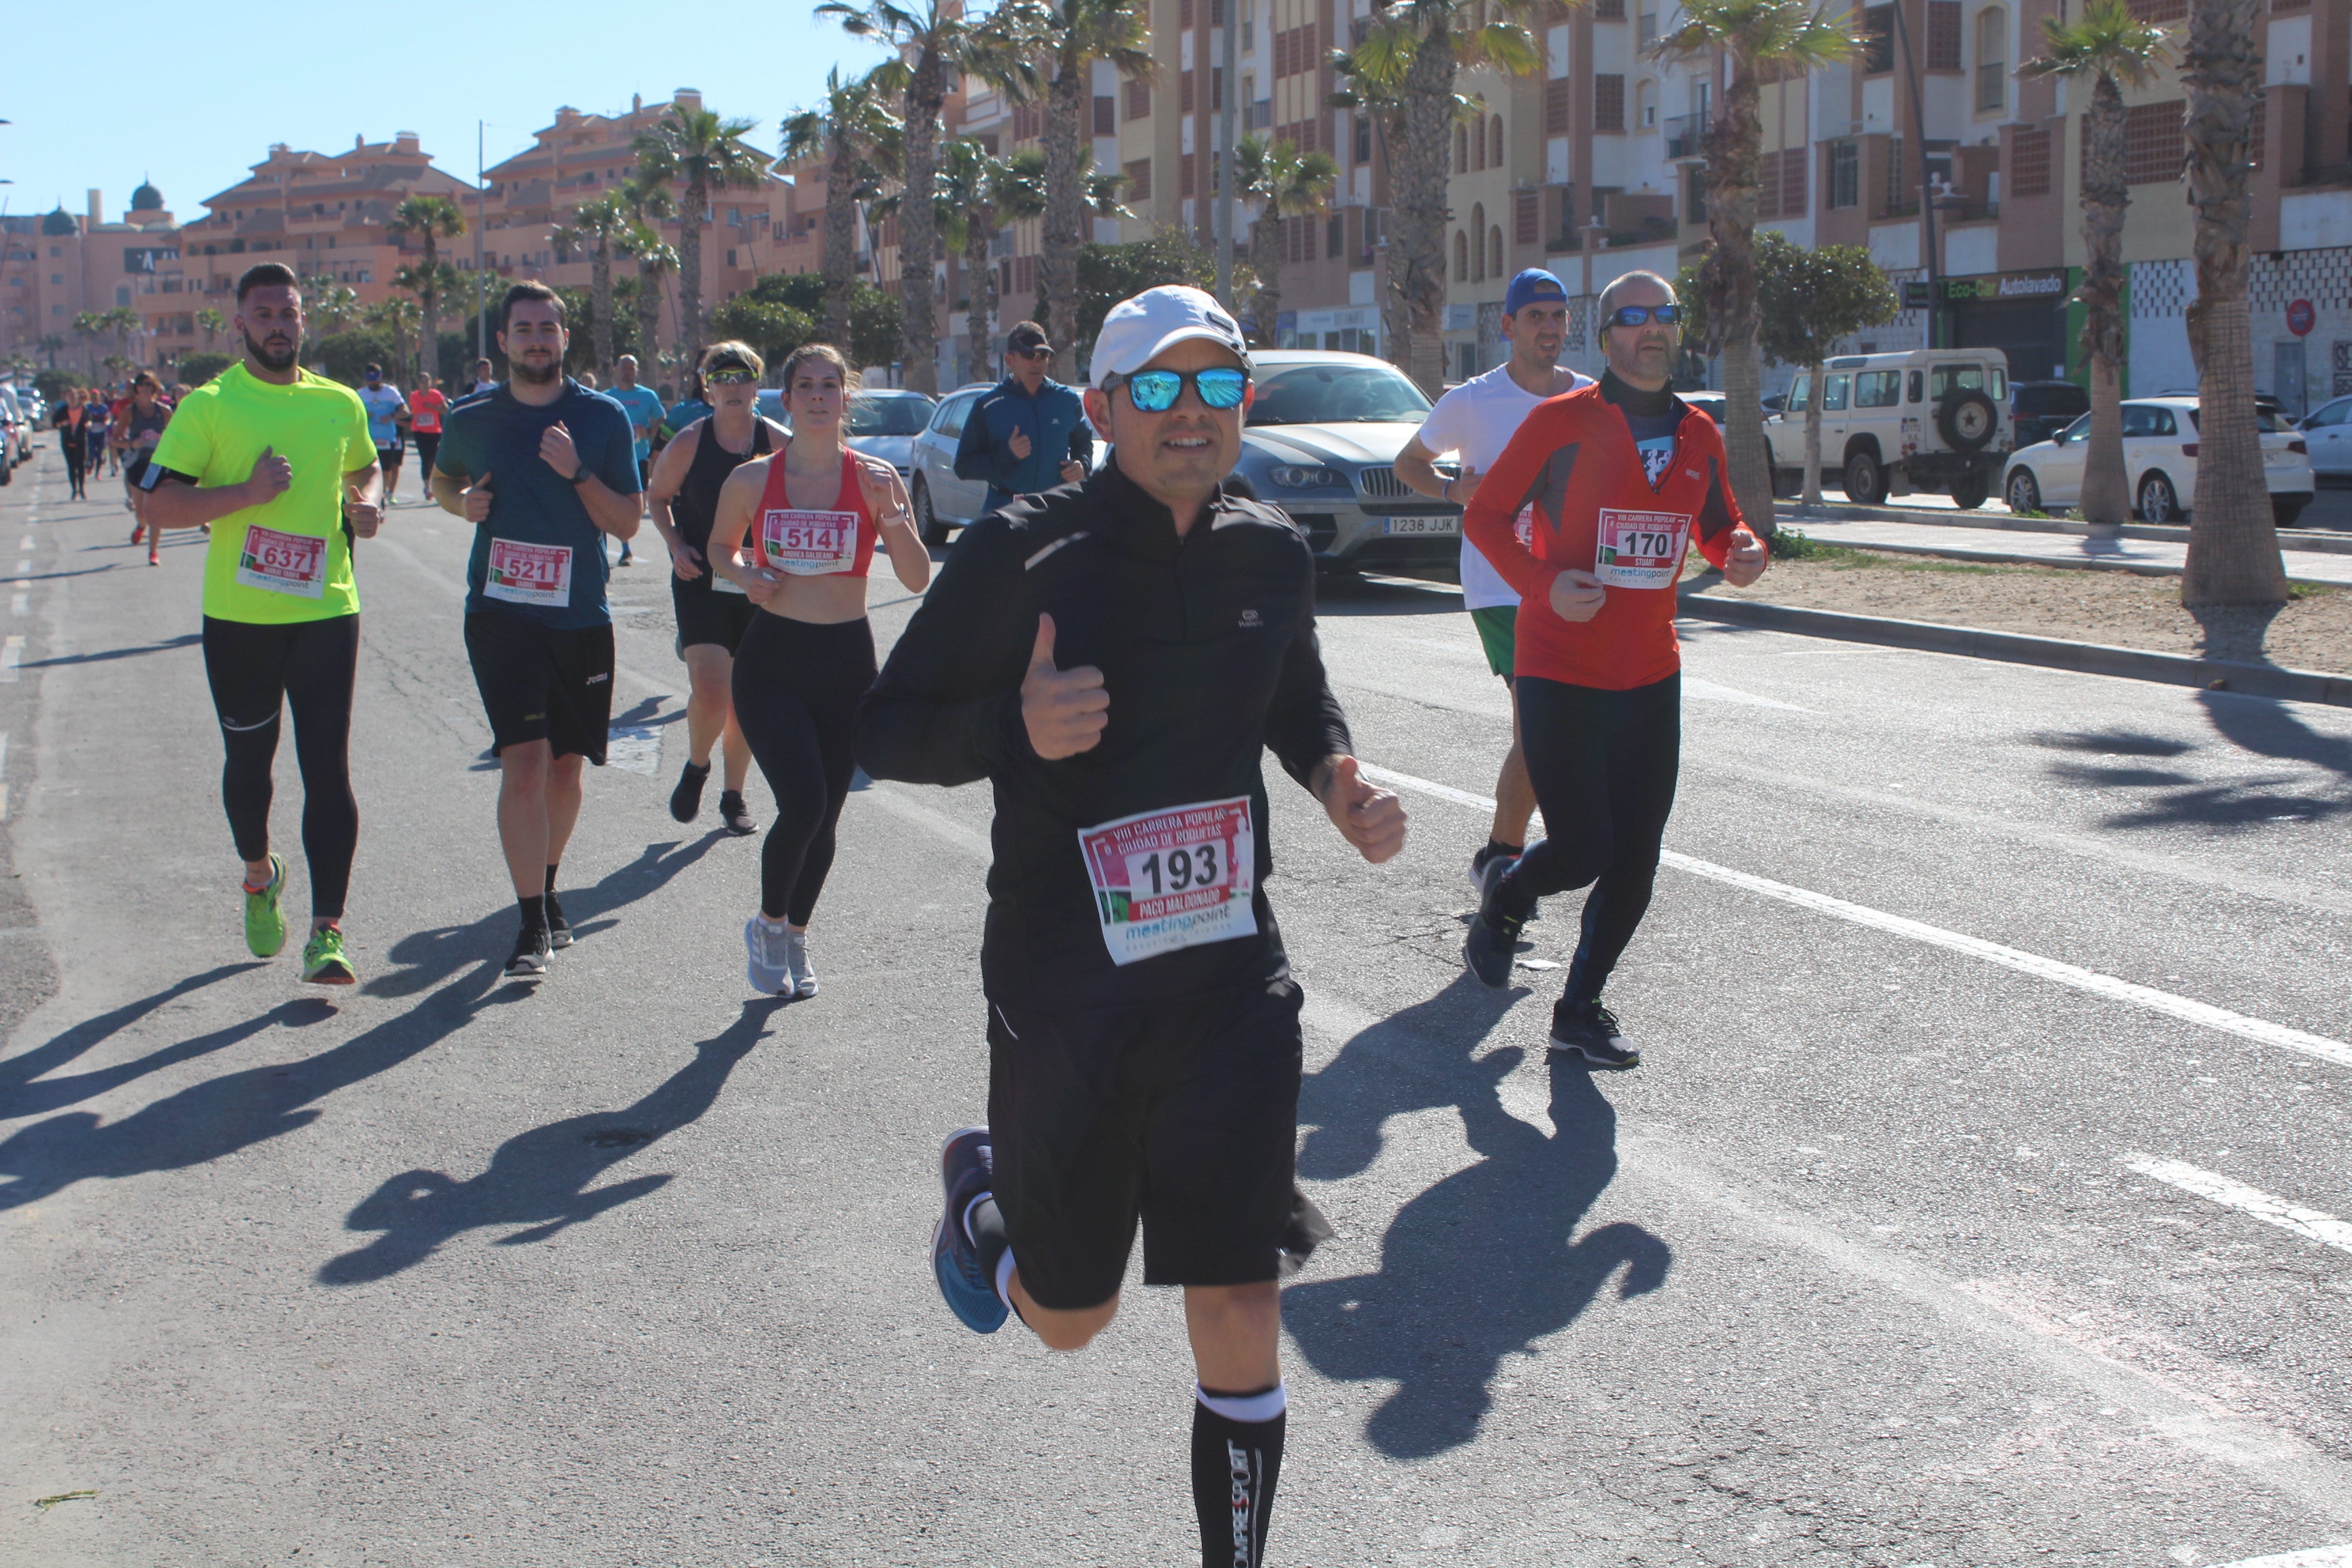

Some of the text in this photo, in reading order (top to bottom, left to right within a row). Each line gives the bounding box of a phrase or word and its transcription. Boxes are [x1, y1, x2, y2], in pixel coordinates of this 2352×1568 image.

[1948, 279, 1997, 298] Eco-Car
[1999, 274, 2061, 295] Autolavado
[1393, 519, 1453, 532] 1238 JJK
[787, 529, 832, 549] 514
[1625, 532, 1667, 555] 170
[264, 547, 306, 569] 637
[777, 558, 839, 569] meetingpoint
[783, 550, 805, 559] ANDREA
[248, 572, 309, 589] meetingpoint
[509, 559, 547, 581] 521
[497, 585, 555, 598] meetingpoint
[1112, 807, 1225, 842] VIII CARRERA POPULAR
[1117, 824, 1222, 855] CIUDAD DE ROQUETAS
[1142, 844, 1218, 895] 193
[1139, 889, 1220, 919] PACO MALDONADO
[1126, 904, 1231, 941] meetingpoint
